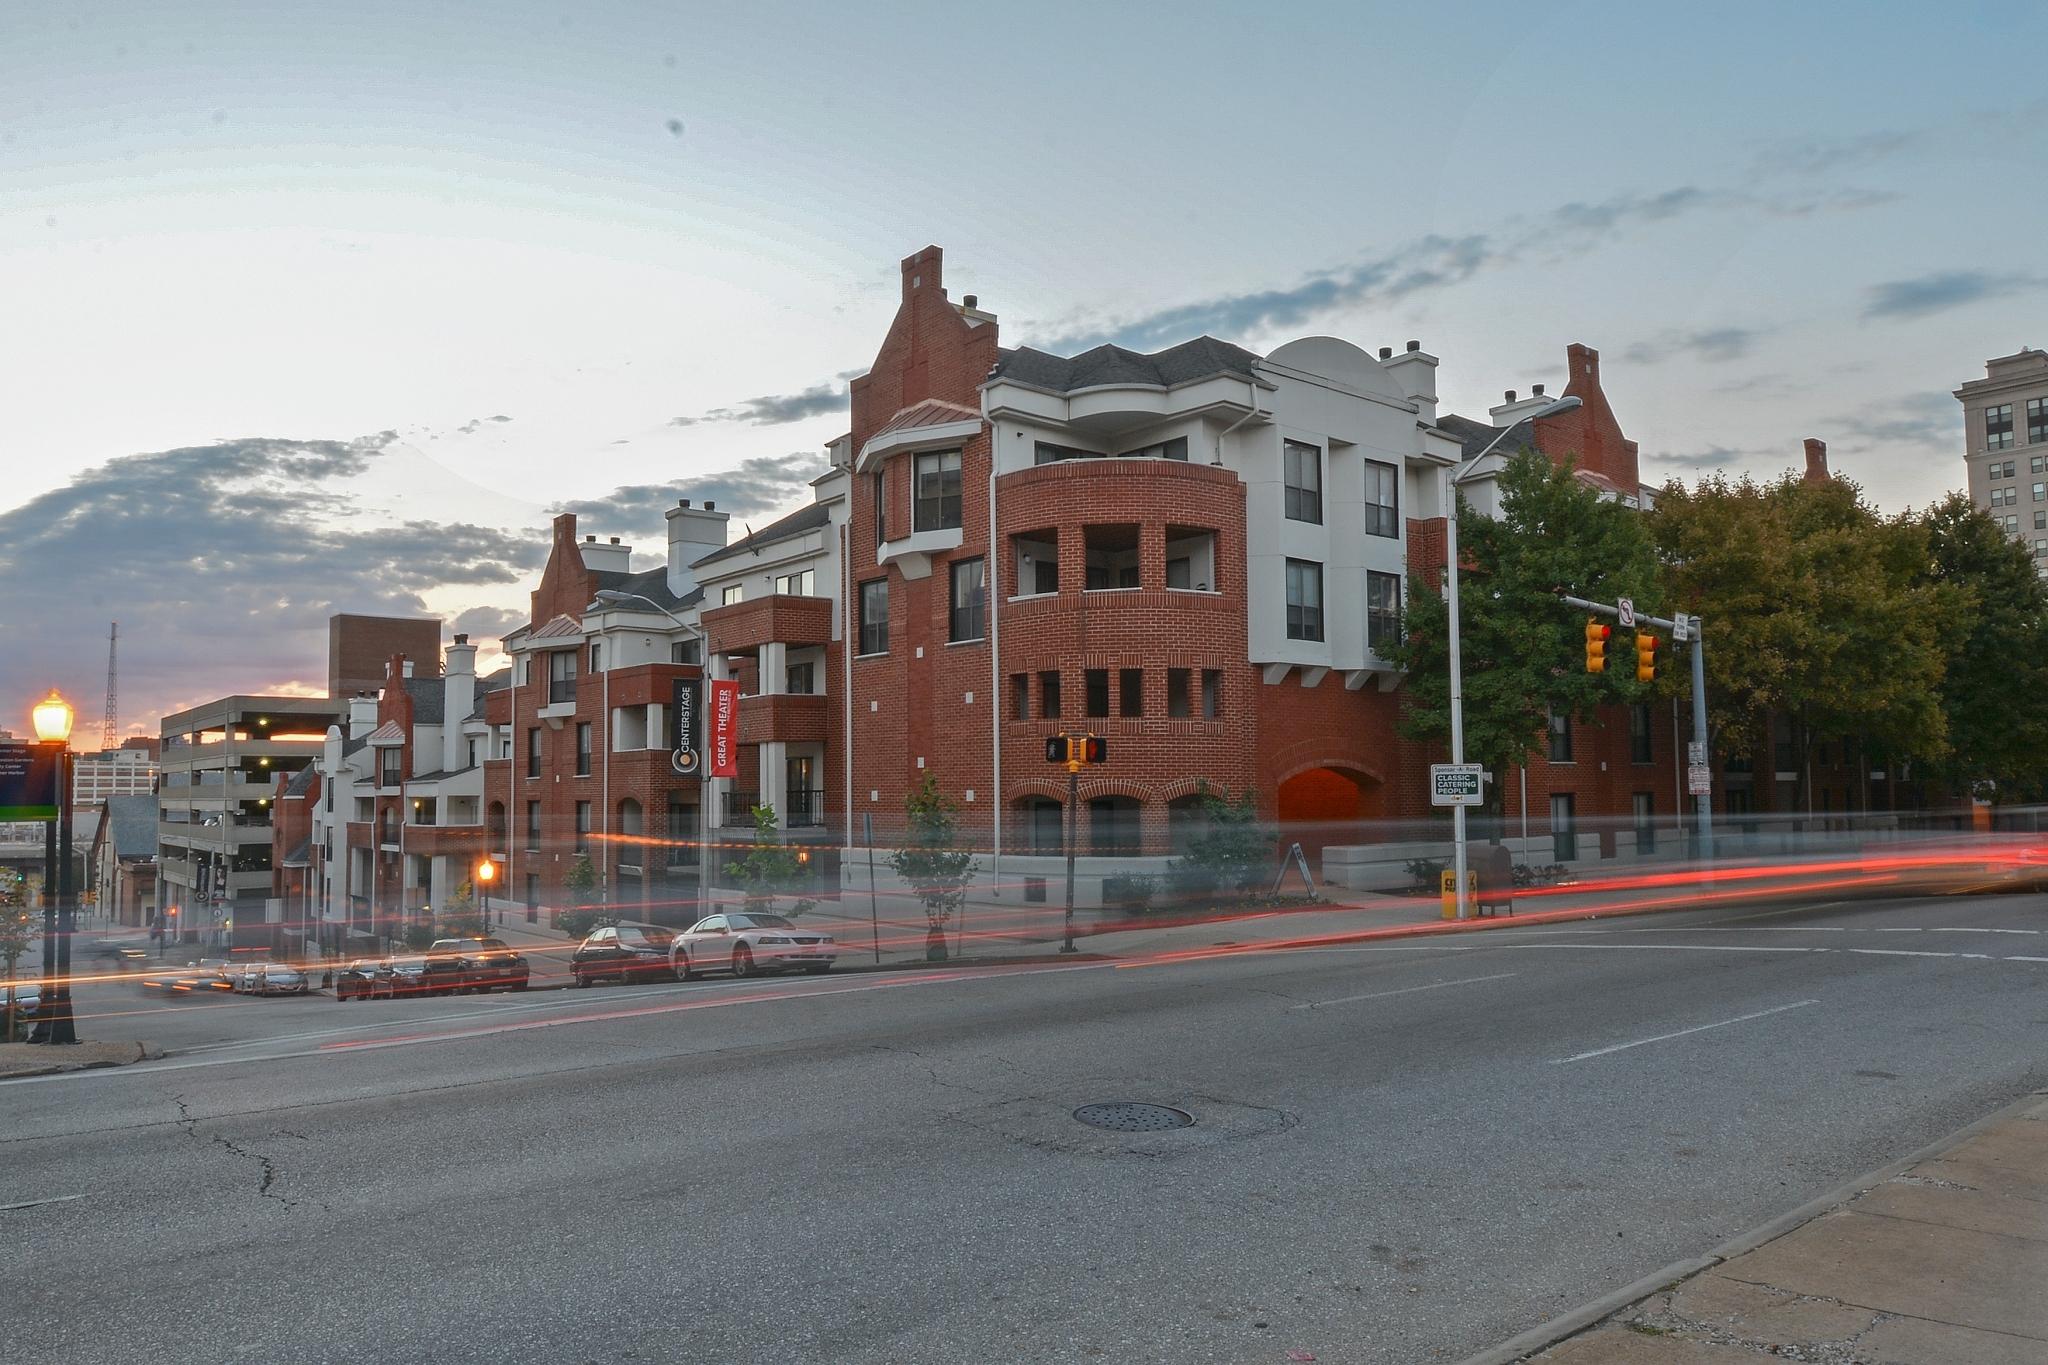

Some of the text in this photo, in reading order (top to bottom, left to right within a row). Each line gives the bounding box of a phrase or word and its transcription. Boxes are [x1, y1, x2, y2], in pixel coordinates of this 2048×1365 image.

[681, 687, 690, 753] CENTERSTAGE
[717, 689, 728, 767] GREAT THEATER
